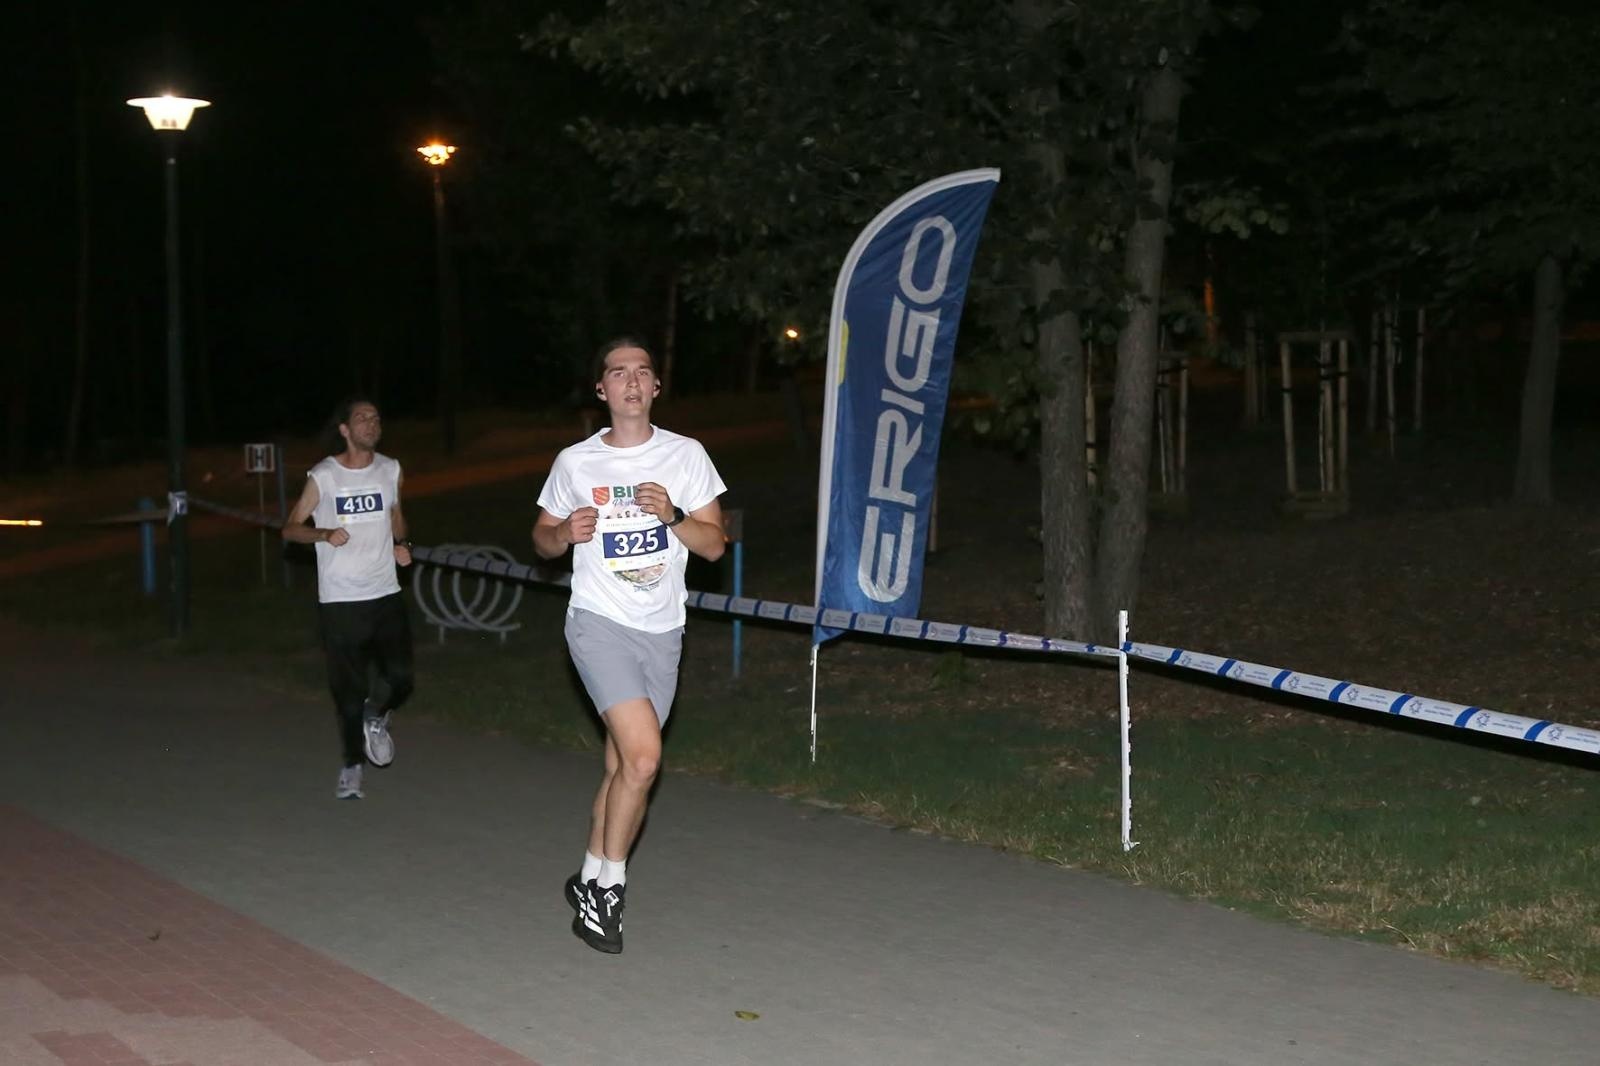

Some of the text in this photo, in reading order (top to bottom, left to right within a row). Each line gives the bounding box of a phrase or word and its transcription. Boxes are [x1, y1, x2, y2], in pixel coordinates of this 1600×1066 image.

[857, 215, 957, 603] ERIGO
[343, 495, 376, 513] 410
[614, 529, 659, 556] 325
